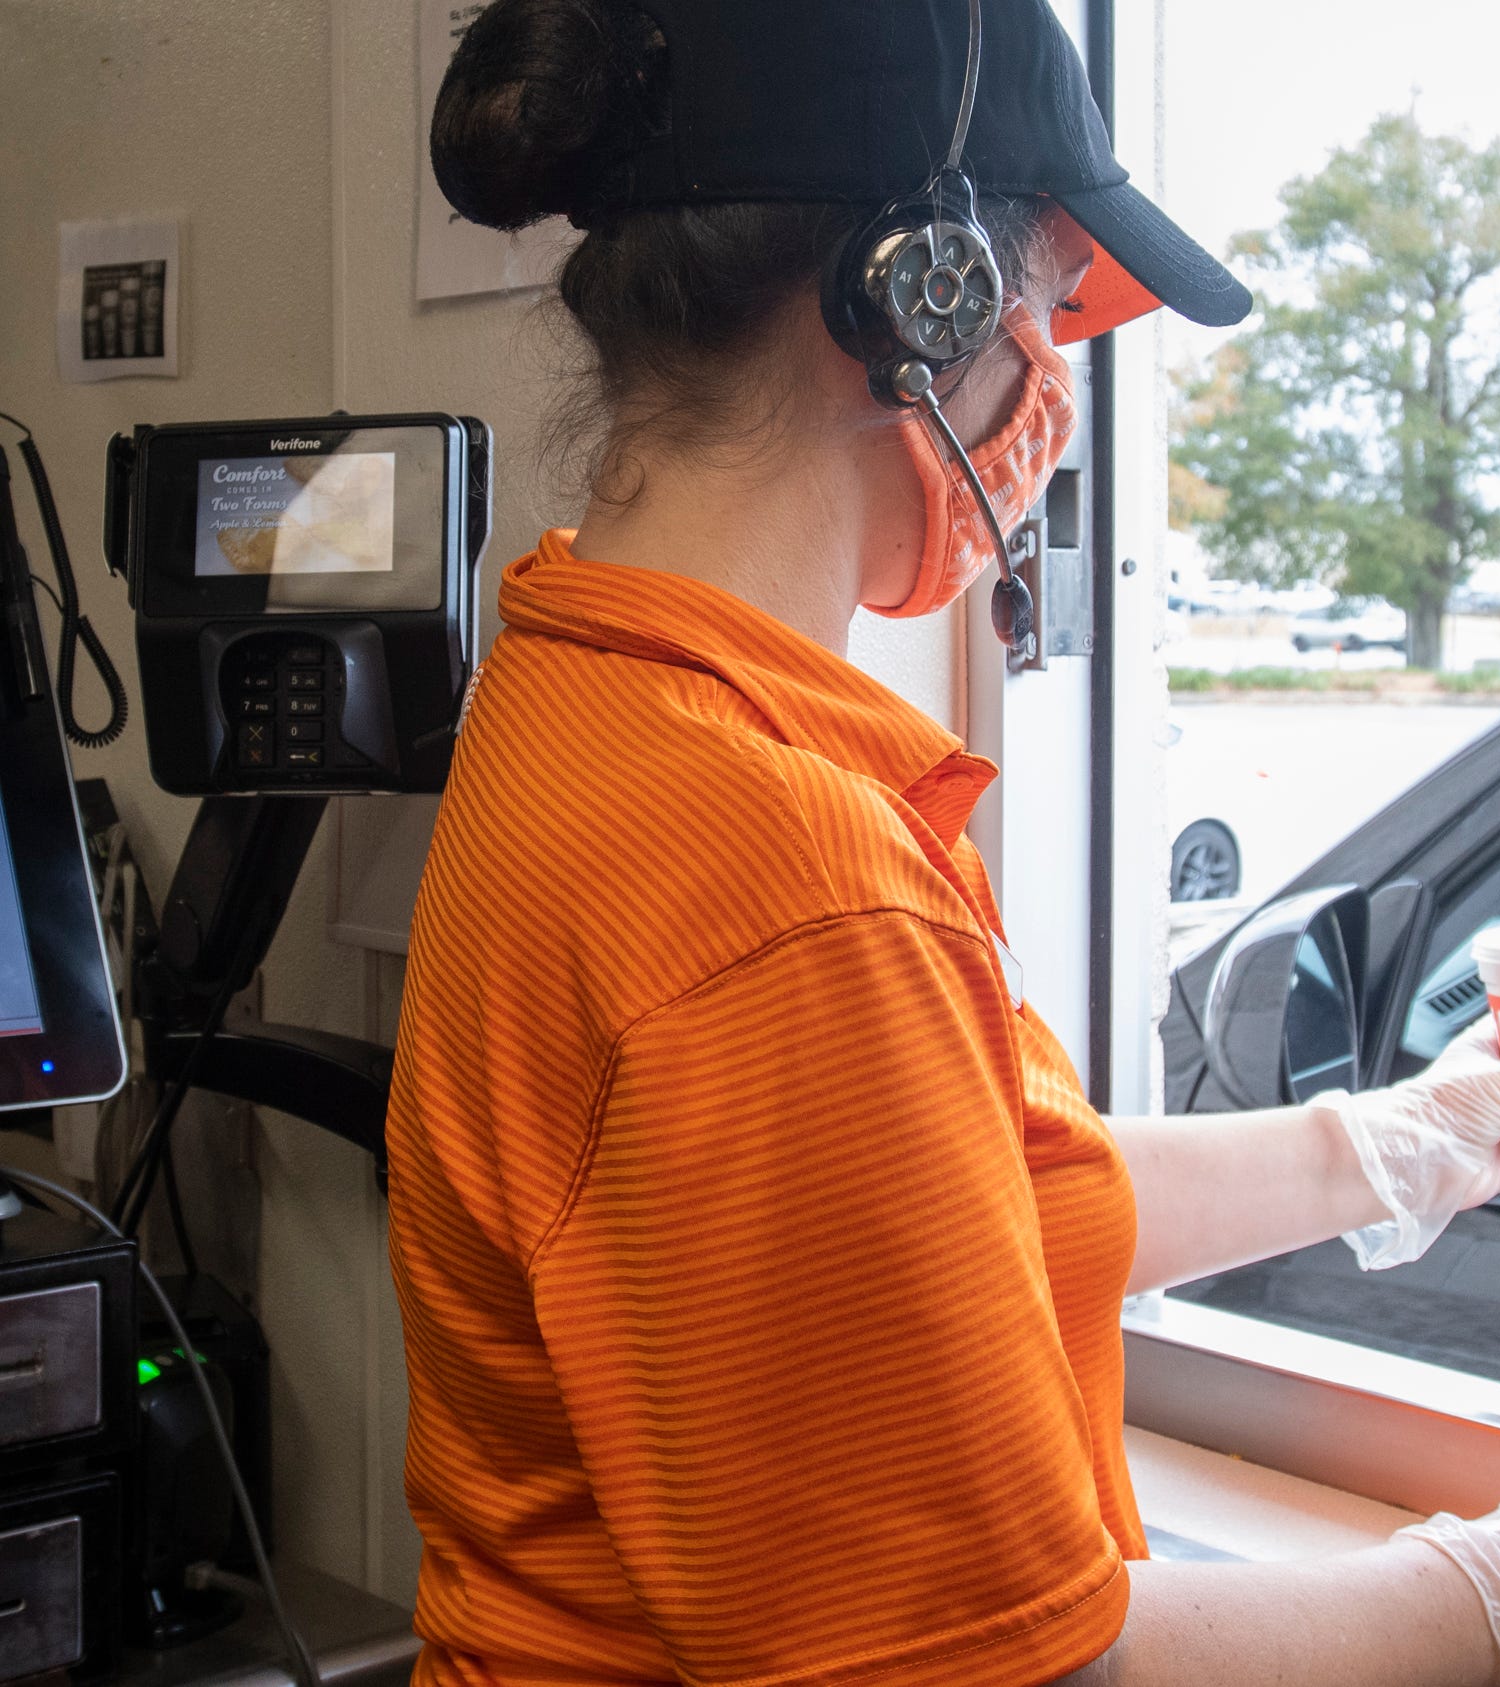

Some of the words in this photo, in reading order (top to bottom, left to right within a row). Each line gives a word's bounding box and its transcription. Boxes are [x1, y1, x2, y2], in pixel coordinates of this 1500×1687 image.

[269, 437, 322, 451] Verifone
[212, 464, 288, 484] Comfort
[210, 496, 240, 512] Two
[243, 495, 289, 512] Forms
[208, 519, 240, 531] Apple
[243, 701, 251, 711] 7
[290, 701, 299, 711] 8
